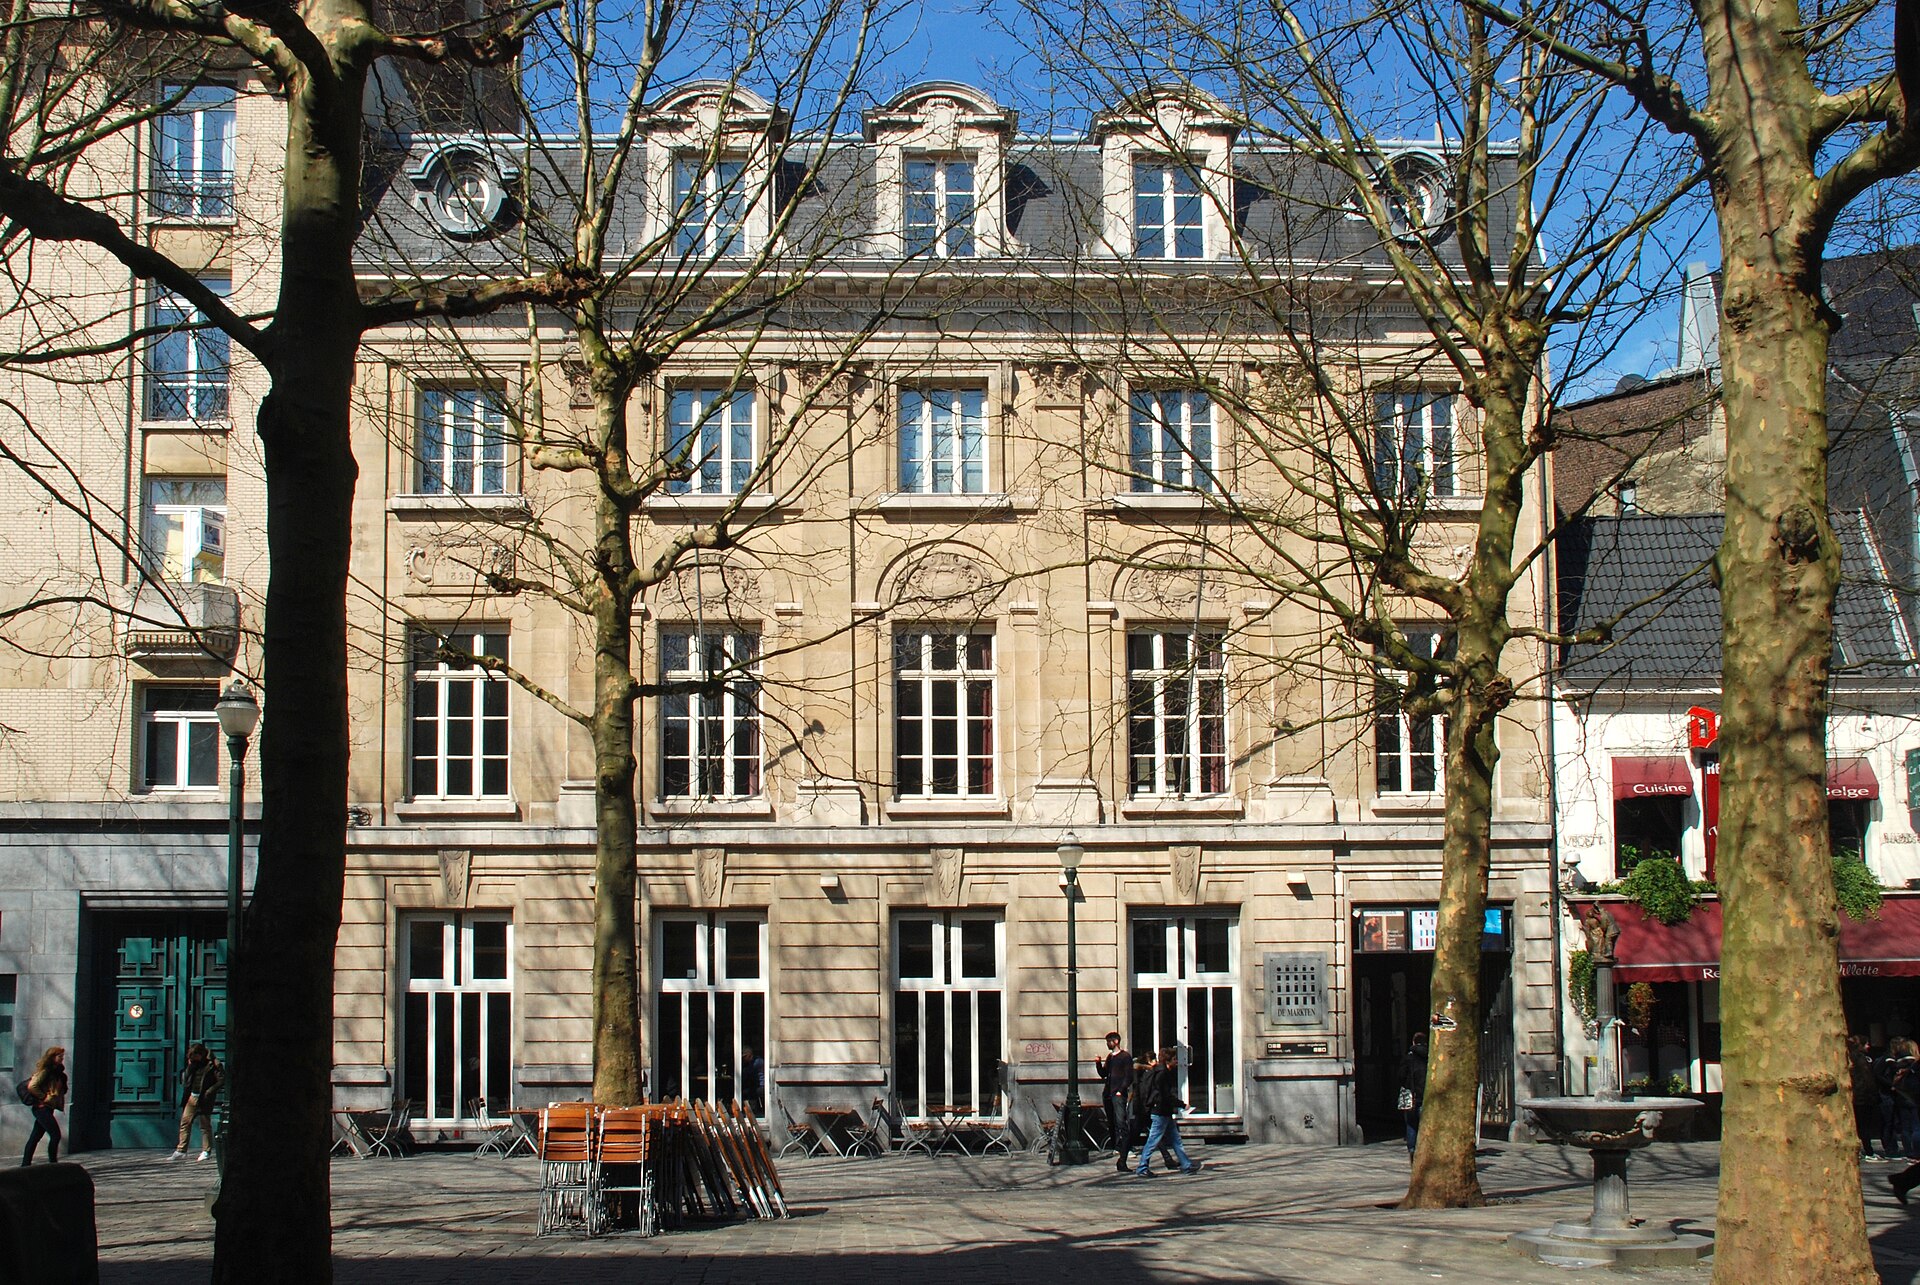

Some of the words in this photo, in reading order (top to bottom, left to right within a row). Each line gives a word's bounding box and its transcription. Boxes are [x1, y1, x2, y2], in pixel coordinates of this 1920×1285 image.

[1633, 783, 1687, 794] Cuisine
[1277, 1009, 1285, 1017] DE
[1287, 1008, 1316, 1017] MARKTEN
